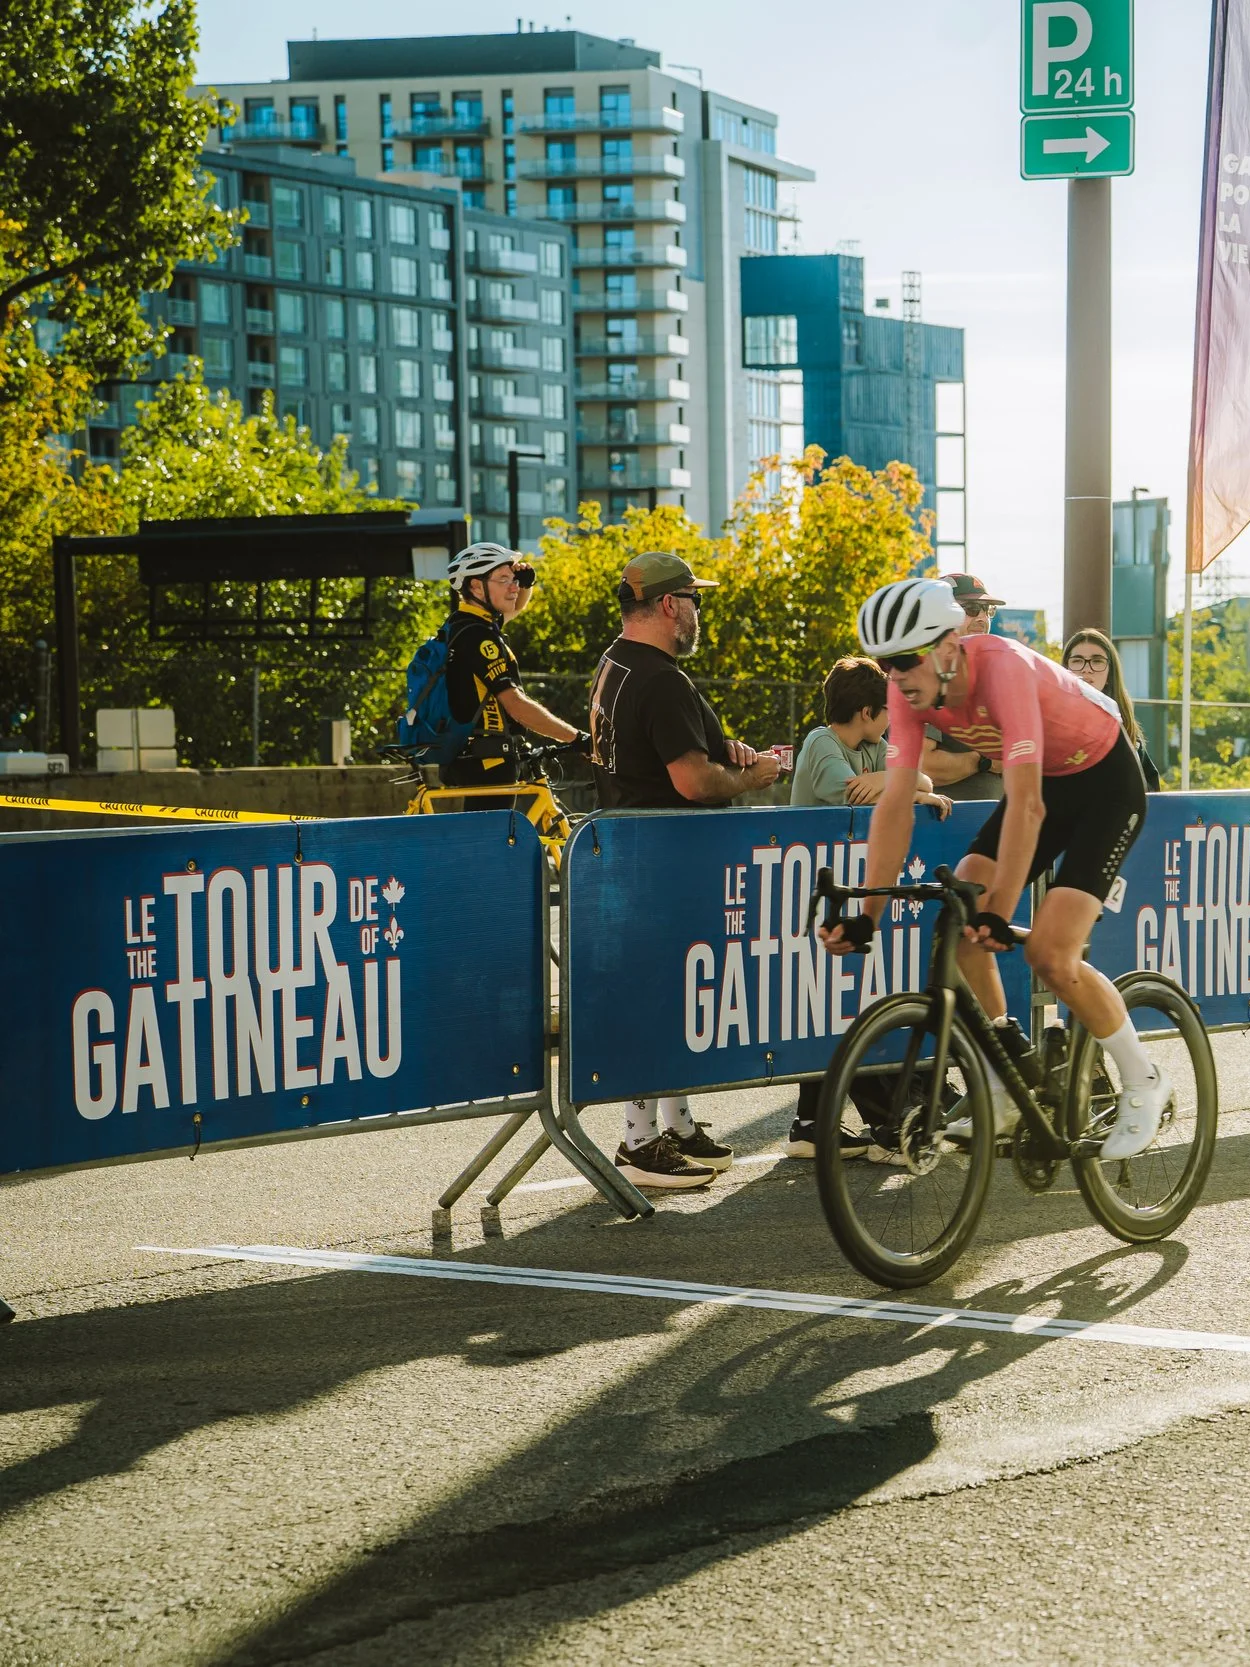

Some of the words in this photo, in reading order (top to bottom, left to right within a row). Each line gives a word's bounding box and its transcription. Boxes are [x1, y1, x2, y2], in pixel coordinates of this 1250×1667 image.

[1032, 2, 1093, 96] P
[1054, 67, 1095, 99] 24
[1104, 66, 1122, 96] h
[1219, 211, 1241, 233] LA
[1219, 240, 1250, 264] VIE
[194, 808, 239, 819] CAUTION
[1164, 840, 1181, 875] LE
[725, 864, 747, 905] LE
[1164, 877, 1180, 901] THE
[124, 896, 156, 944] LE
[163, 862, 342, 986] TOUR
[350, 876, 379, 923] DE
[725, 908, 746, 935] THE
[892, 897, 905, 922] OF
[126, 948, 157, 979] THE
[361, 926, 379, 955] OF
[685, 925, 920, 1053] GATINEAU
[72, 959, 402, 1120] GATINEAU
